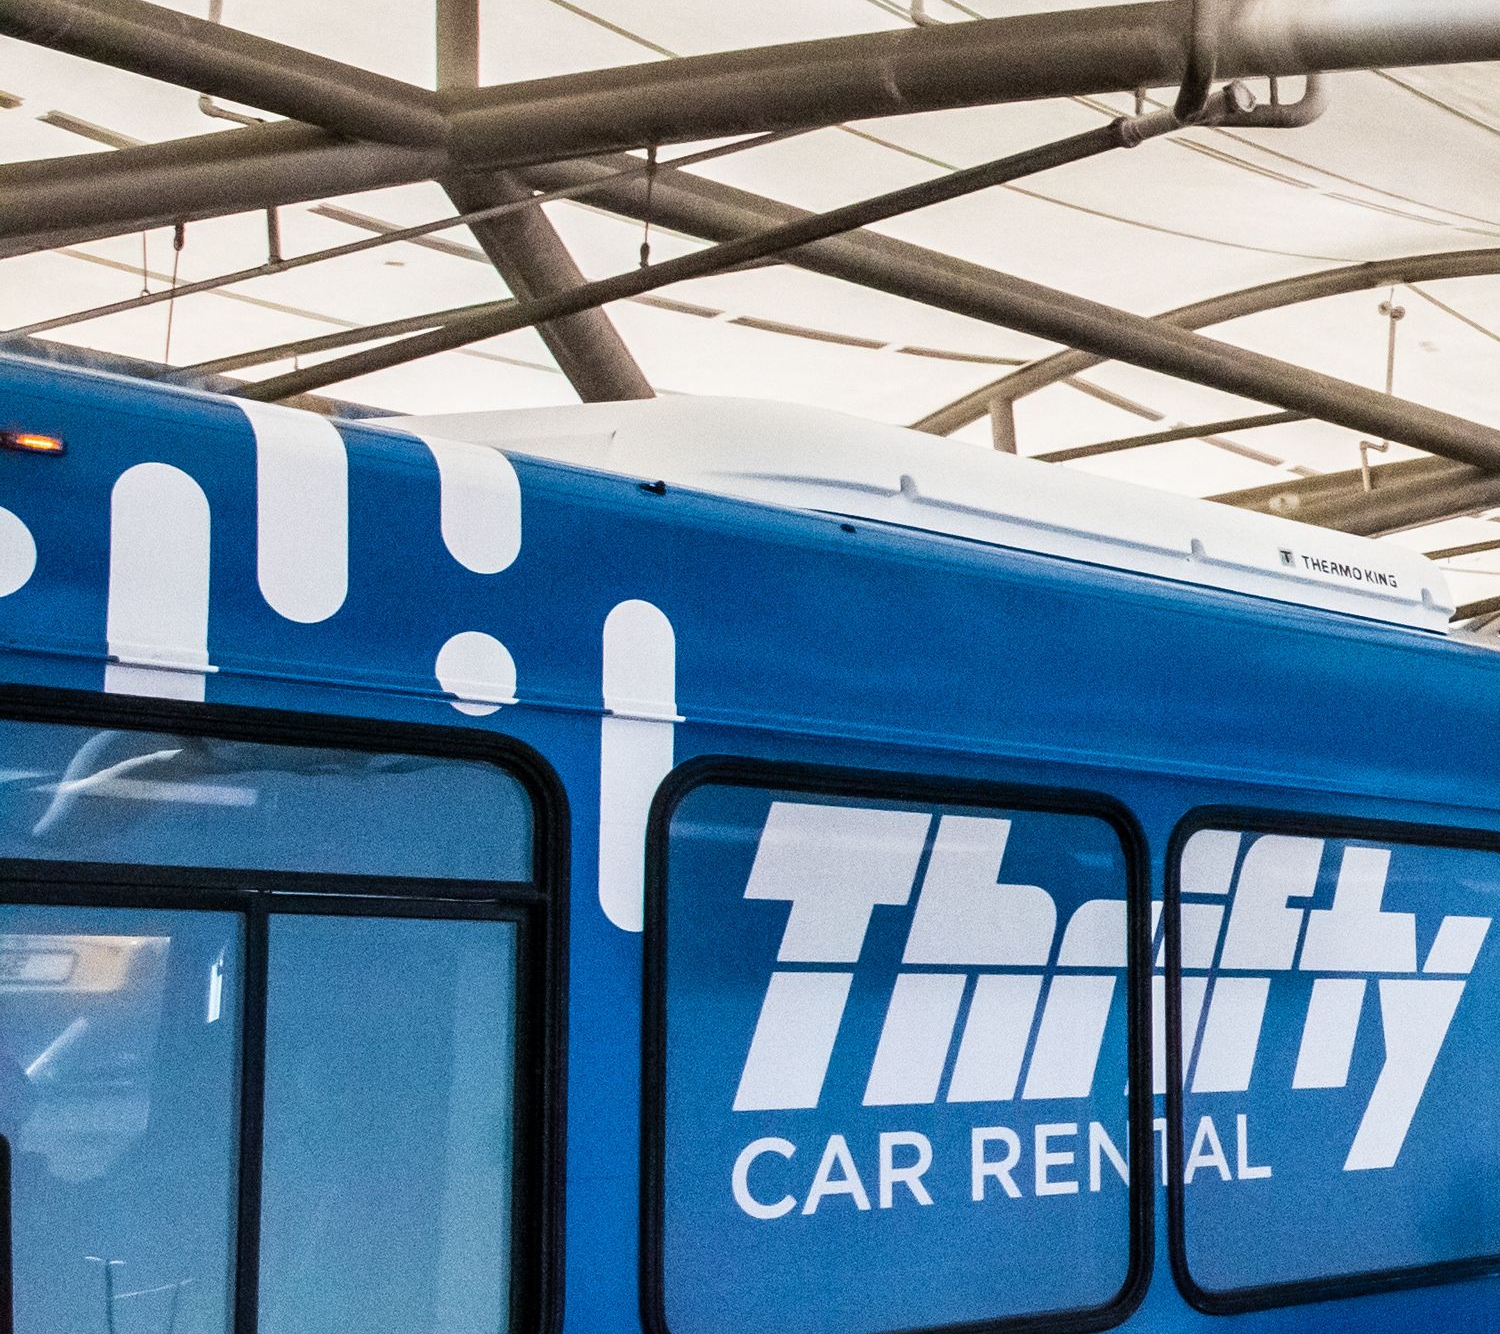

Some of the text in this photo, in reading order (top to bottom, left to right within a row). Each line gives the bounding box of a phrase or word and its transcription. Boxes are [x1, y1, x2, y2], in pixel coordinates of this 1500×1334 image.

[1301, 555, 1362, 581] THERMO
[1365, 569, 1398, 589] KING
[731, 801, 1493, 1172] Thrifty
[731, 1114, 1273, 1220] CAR RENTAL
